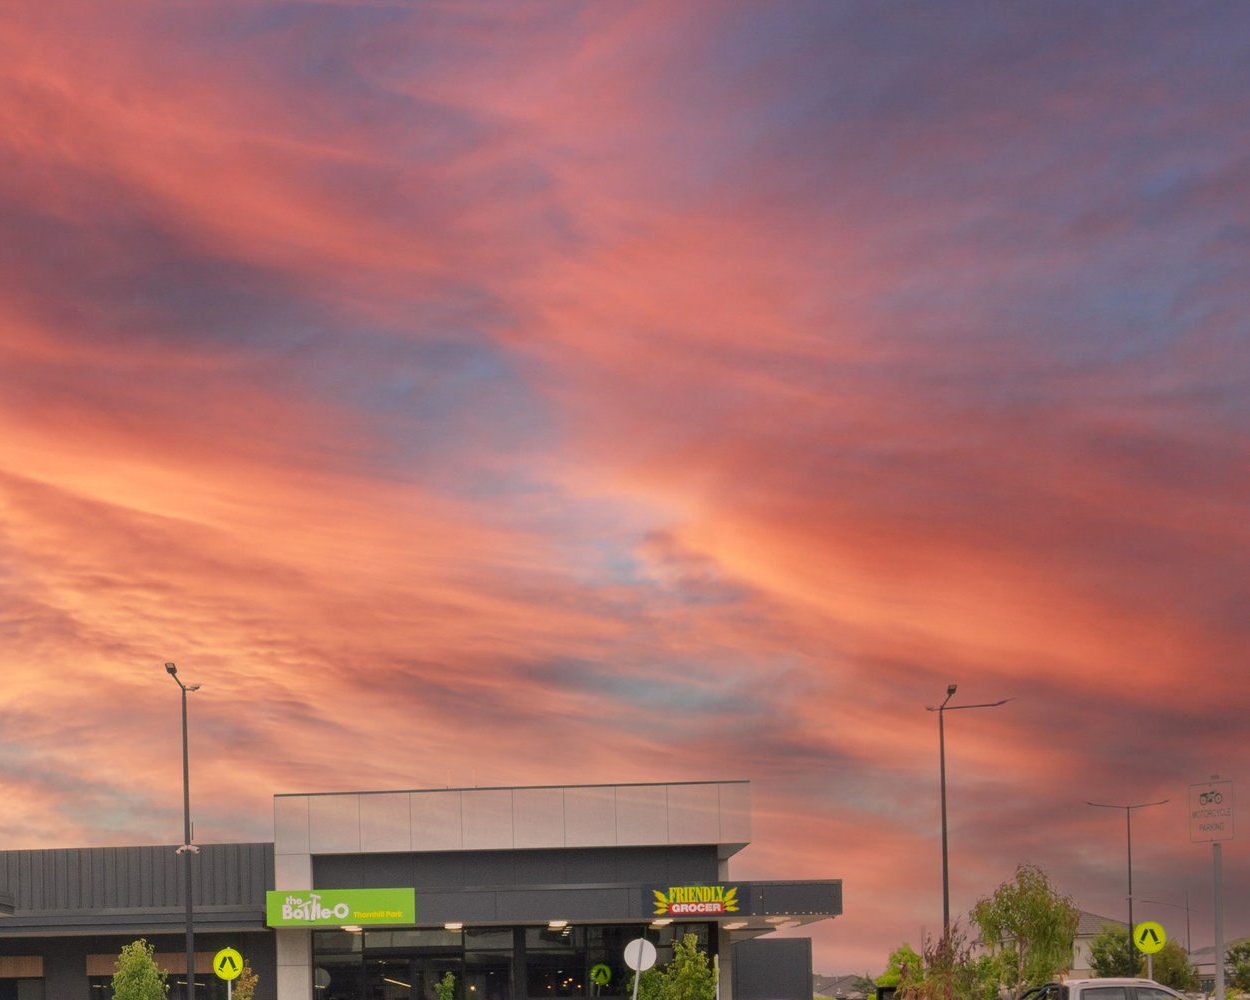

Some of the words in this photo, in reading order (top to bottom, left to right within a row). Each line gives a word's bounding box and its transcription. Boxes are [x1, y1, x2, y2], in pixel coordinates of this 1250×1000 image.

[1192, 808, 1231, 819] MOTORCYCLE
[1199, 822, 1224, 833] PARKING
[669, 885, 725, 904] FRIENDLY
[285, 895, 303, 906] the
[671, 903, 722, 913] GROCER
[353, 911, 385, 919] Thornhill
[386, 911, 403, 919] Park
